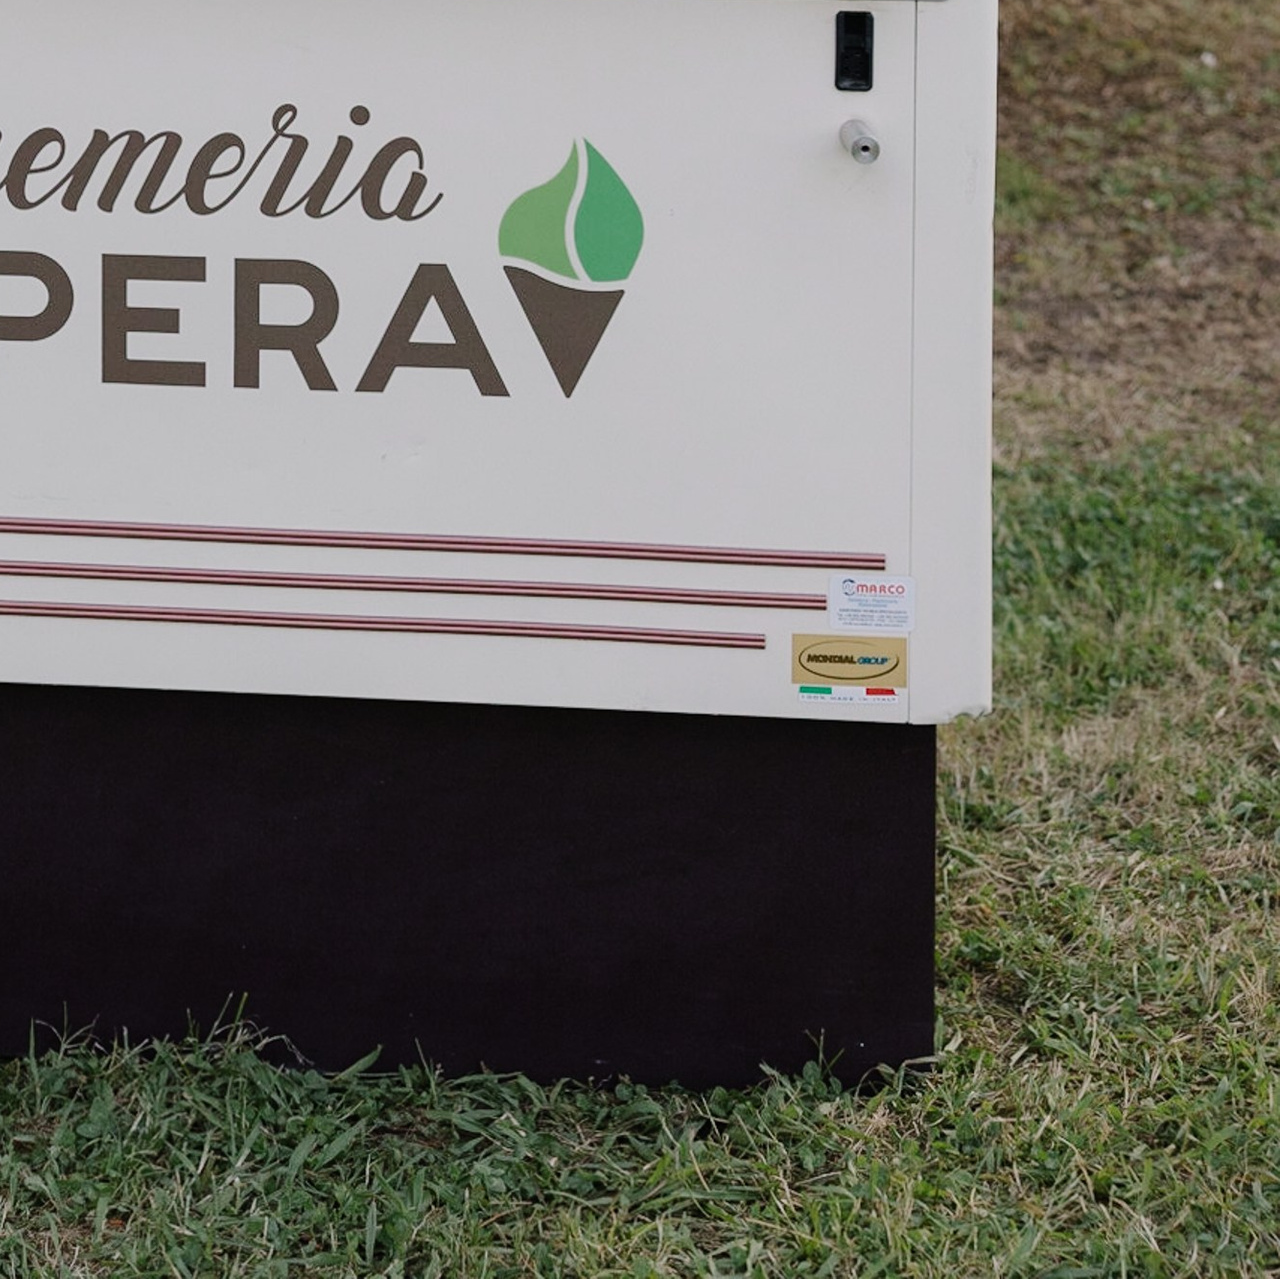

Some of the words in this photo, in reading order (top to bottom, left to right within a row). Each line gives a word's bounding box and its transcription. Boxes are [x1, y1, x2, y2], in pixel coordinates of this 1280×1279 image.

[856, 583, 906, 595] MARCO
[807, 653, 857, 665] MONDIAL
[857, 656, 889, 665] GROUP
